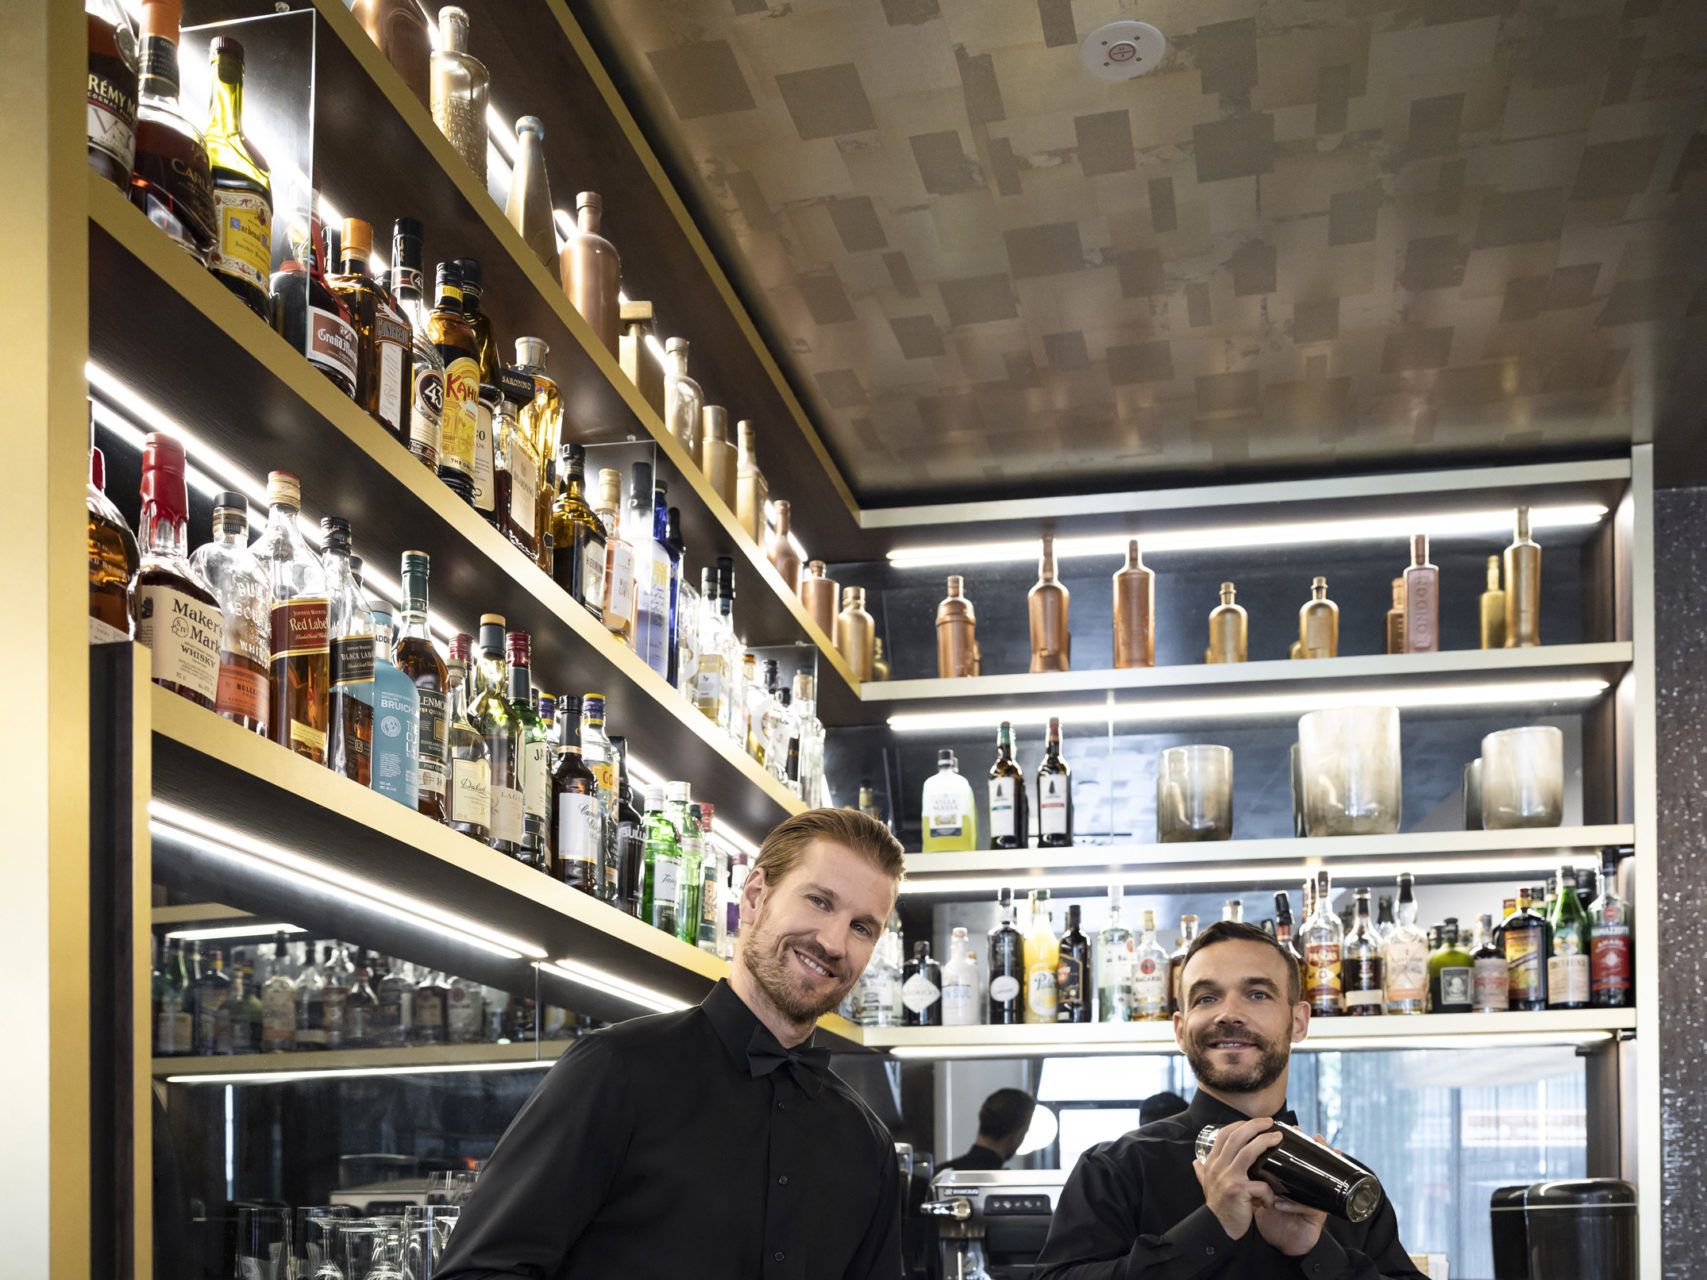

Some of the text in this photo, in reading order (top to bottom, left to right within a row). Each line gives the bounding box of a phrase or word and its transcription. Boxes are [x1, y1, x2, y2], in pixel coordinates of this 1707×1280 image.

[88, 74, 127, 108] RÉMY
[424, 381, 443, 411] 43
[172, 598, 224, 639] Maker's
[289, 618, 307, 632] Red
[1416, 575, 1427, 647] LONDON
[181, 644, 217, 669] WHISKY
[341, 652, 360, 662] BLACK
